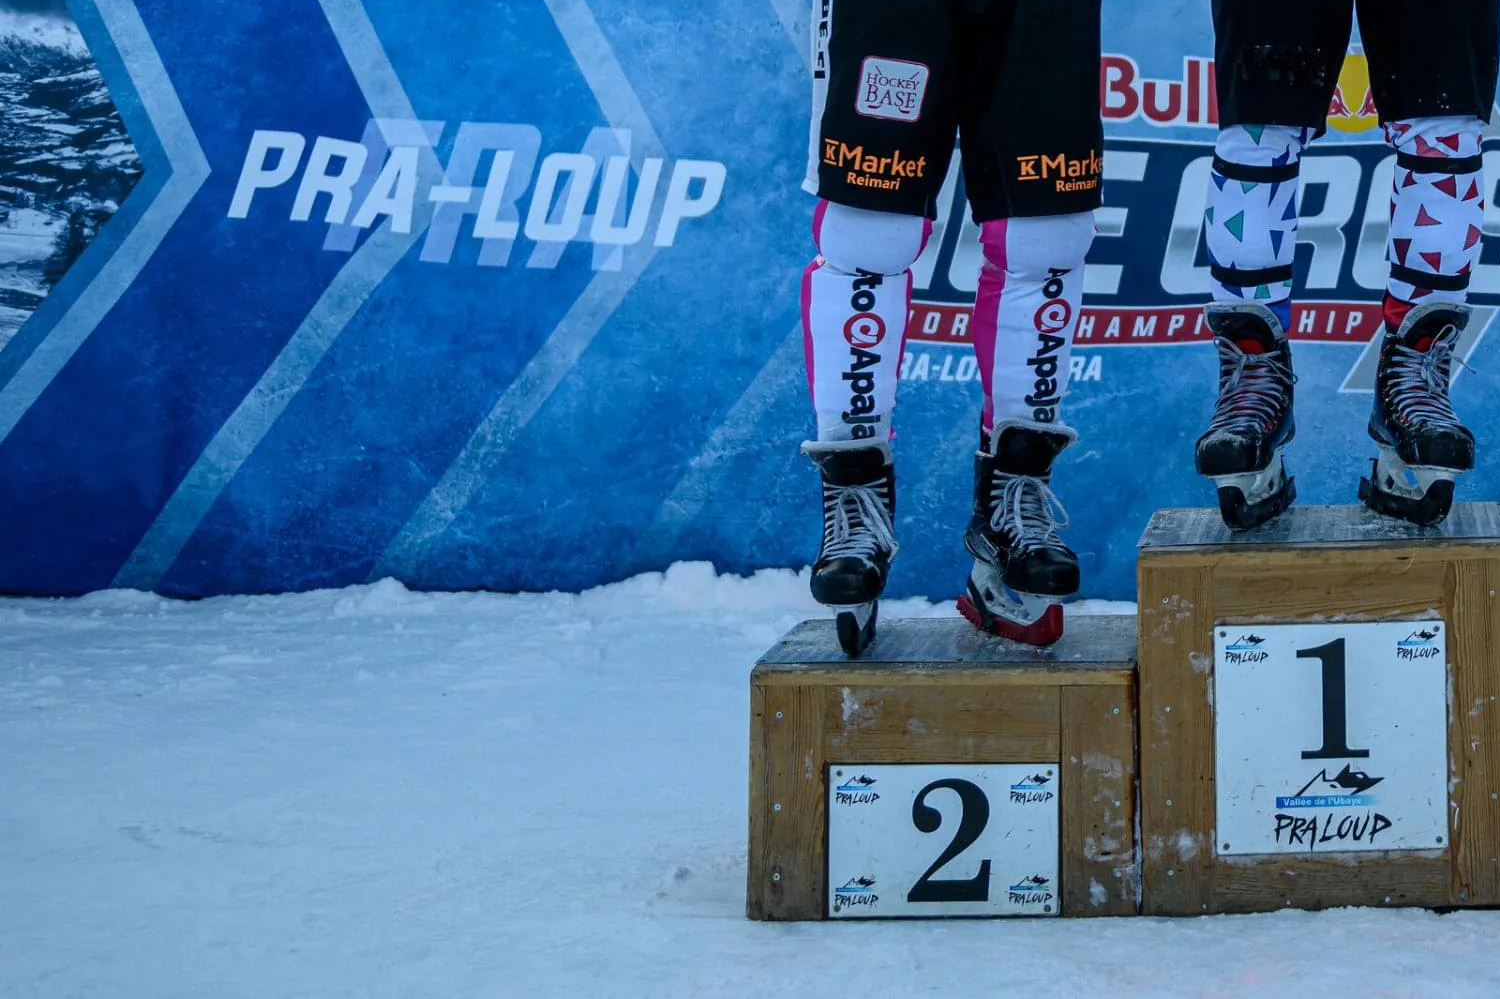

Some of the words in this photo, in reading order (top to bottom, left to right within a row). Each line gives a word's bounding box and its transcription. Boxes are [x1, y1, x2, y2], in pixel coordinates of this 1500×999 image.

[865, 84, 917, 109] BASE
[866, 73, 921, 90] HOCKEY
[1100, 53, 1219, 128] Bull
[226, 129, 728, 247] PRA-LOUP
[846, 171, 901, 190] Reimari
[1296, 637, 1370, 760] 1
[1314, 798, 1326, 807] de
[907, 778, 992, 902] 2
